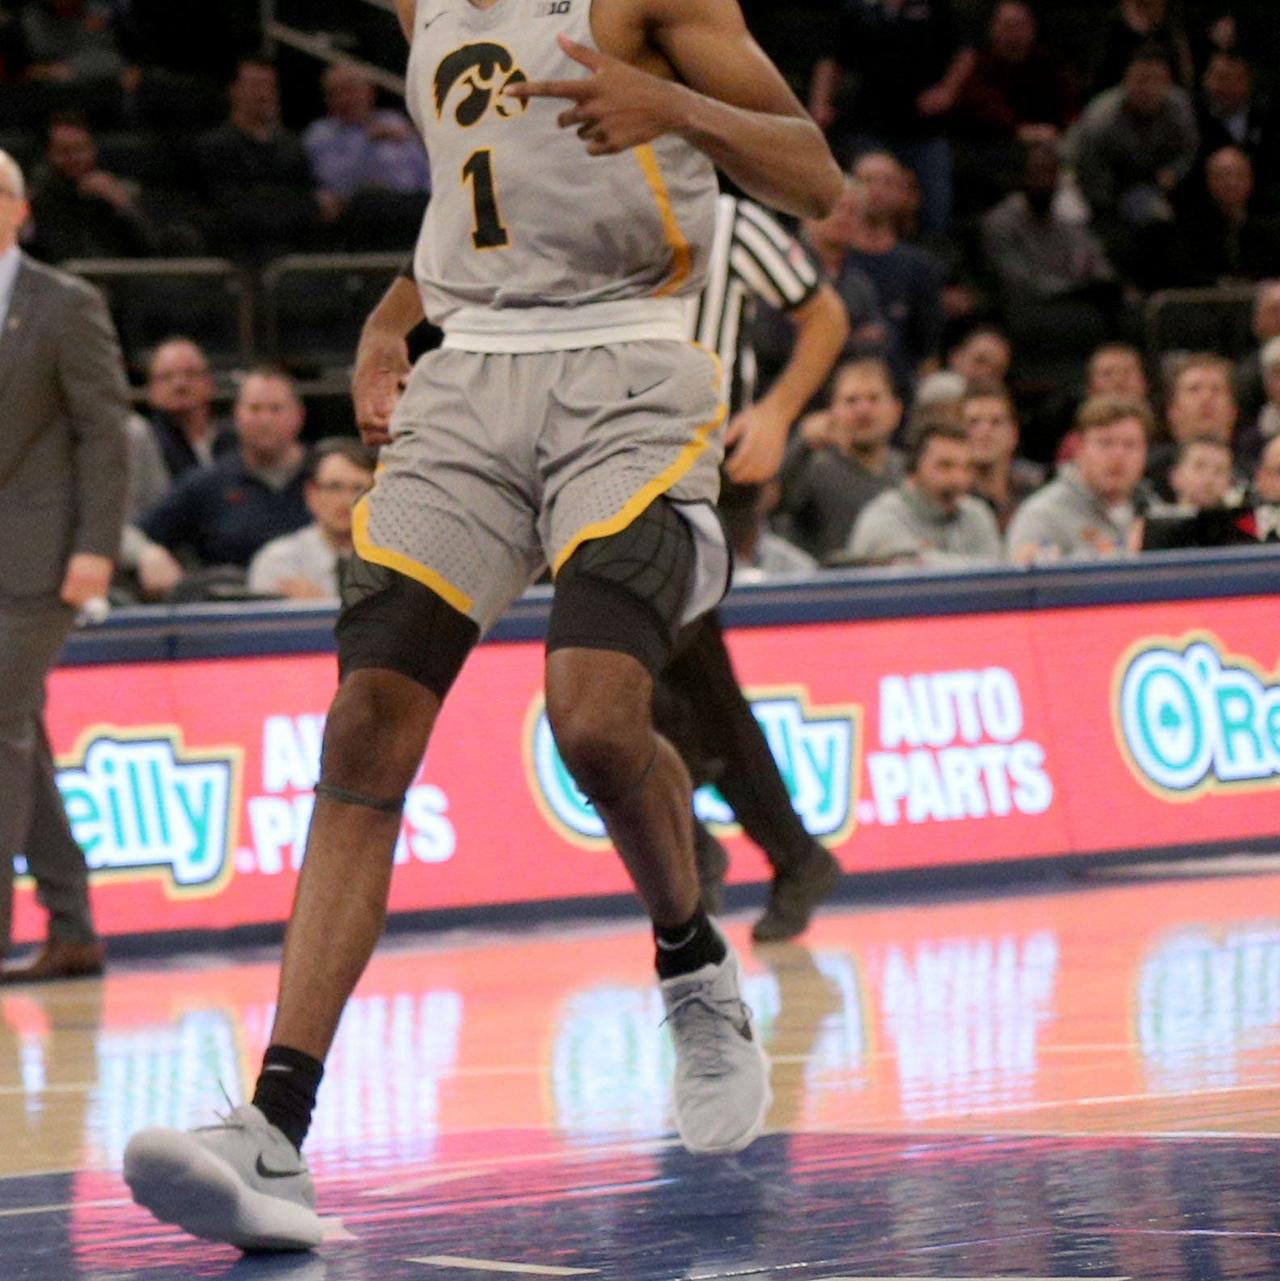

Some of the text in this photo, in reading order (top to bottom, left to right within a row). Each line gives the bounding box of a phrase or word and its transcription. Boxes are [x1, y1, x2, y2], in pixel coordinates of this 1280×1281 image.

[463, 147, 512, 252] 1
[878, 667, 1023, 748] AUTO
[867, 741, 1054, 826] PARTS
